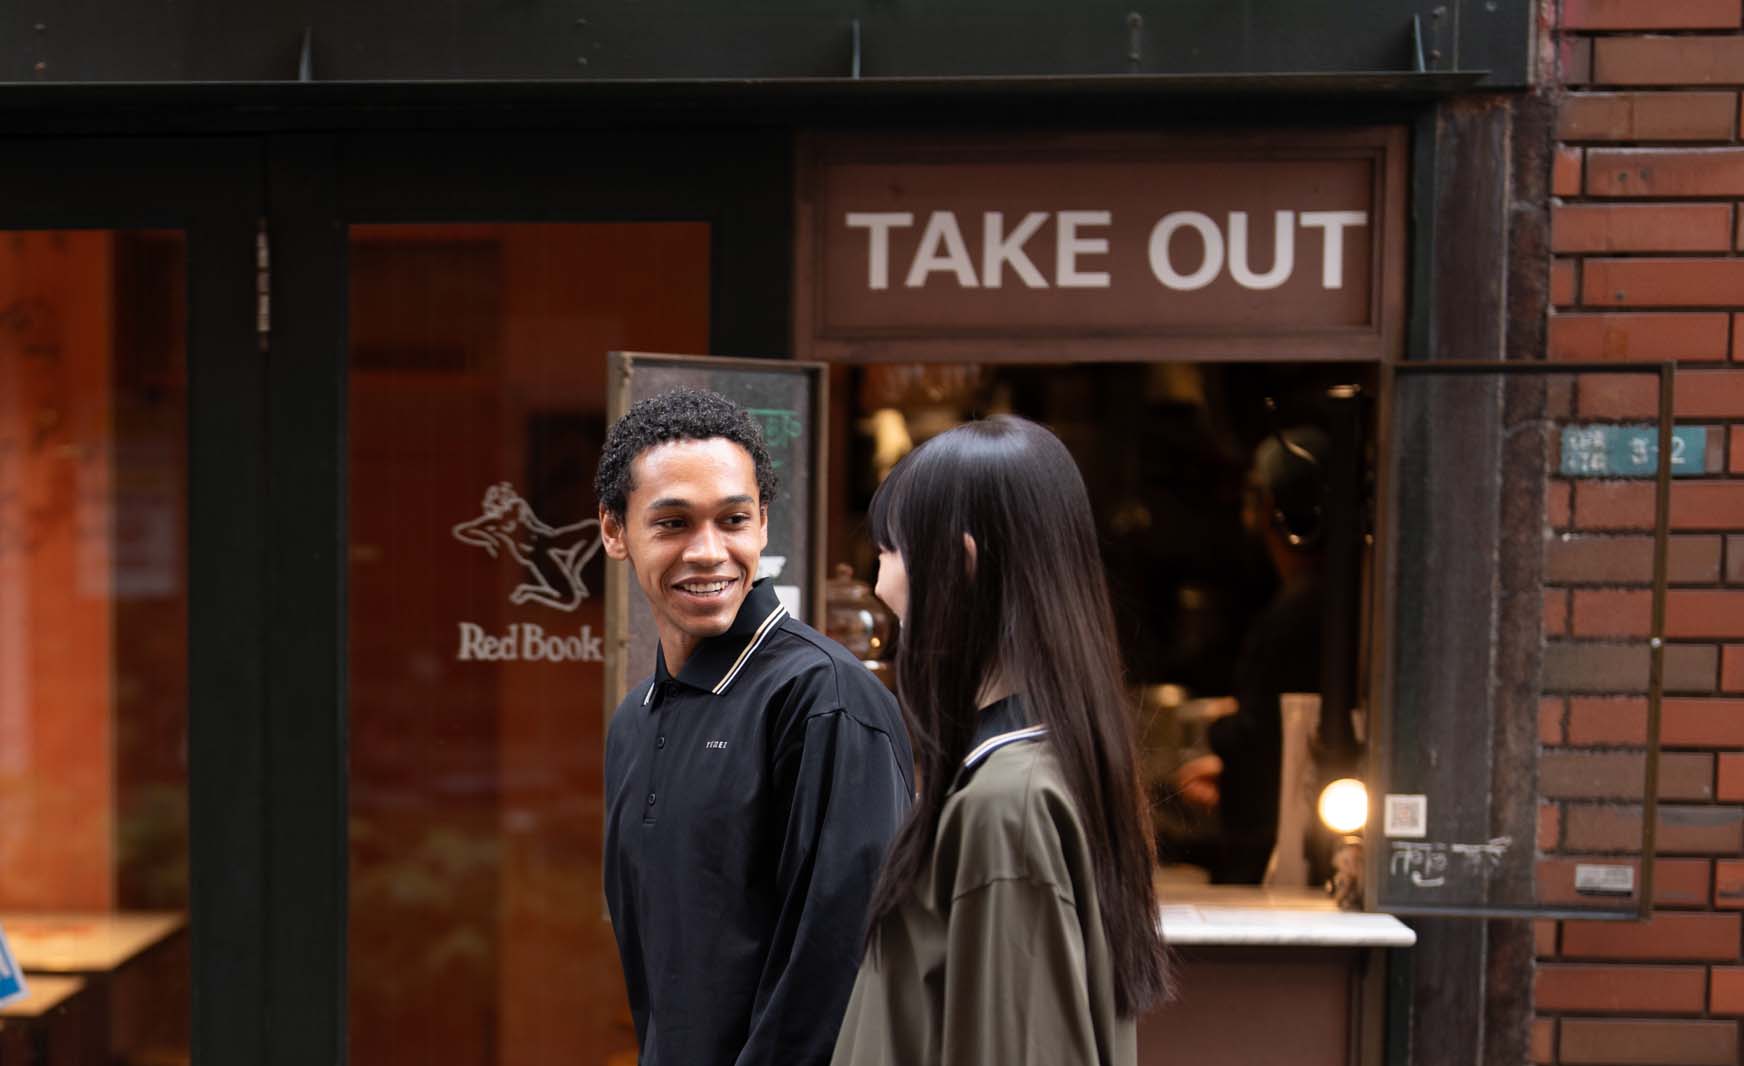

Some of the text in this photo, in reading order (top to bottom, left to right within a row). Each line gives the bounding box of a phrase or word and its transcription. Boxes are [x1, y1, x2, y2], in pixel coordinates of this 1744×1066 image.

[845, 209, 1369, 291] TAKE OUT
[456, 622, 604, 662] Red Book
